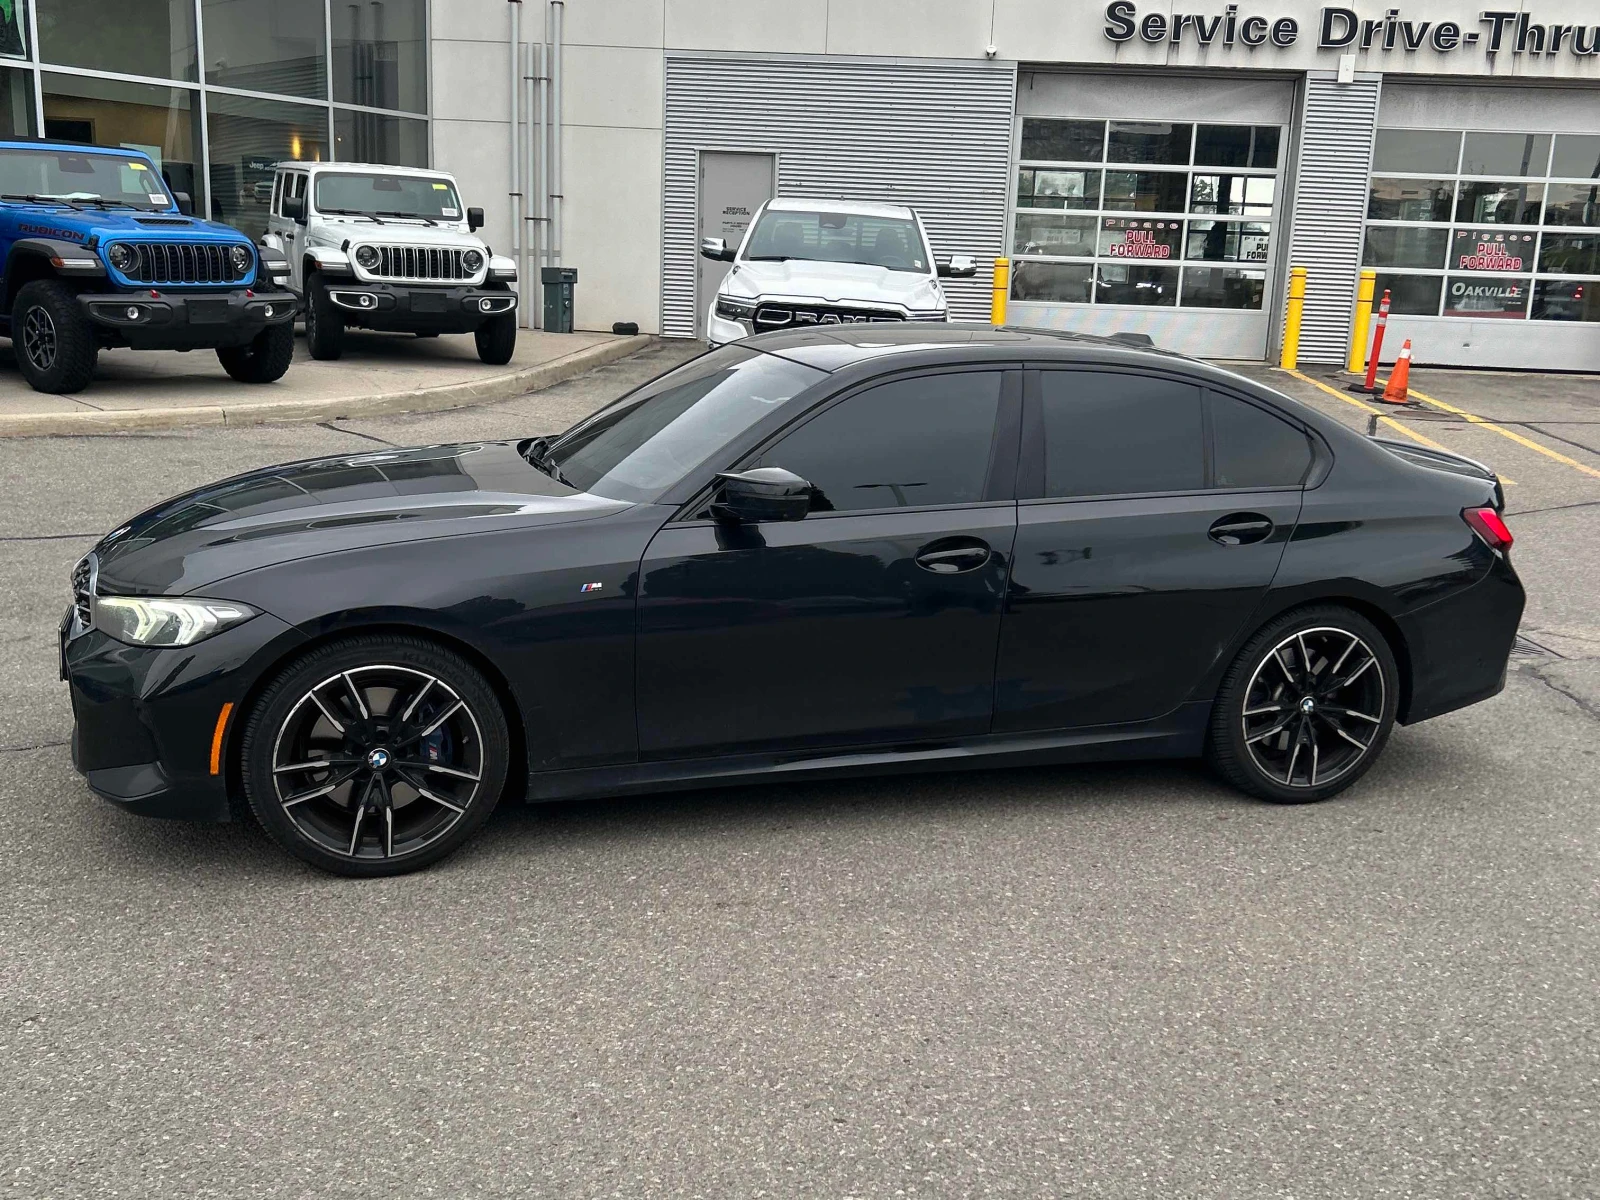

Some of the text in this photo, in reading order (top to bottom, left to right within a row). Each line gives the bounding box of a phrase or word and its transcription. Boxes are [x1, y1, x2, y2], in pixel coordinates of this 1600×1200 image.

[1103, 0, 1600, 55] Service Drive-Thru
[249, 161, 264, 170] Jeep
[19, 223, 85, 240] RUBICON
[1126, 230, 1156, 244] PULL
[1110, 243, 1170, 258] FORWARD
[1477, 242, 1508, 257] PULL
[1459, 255, 1522, 271] FORWARD
[795, 311, 866, 324] RAM
